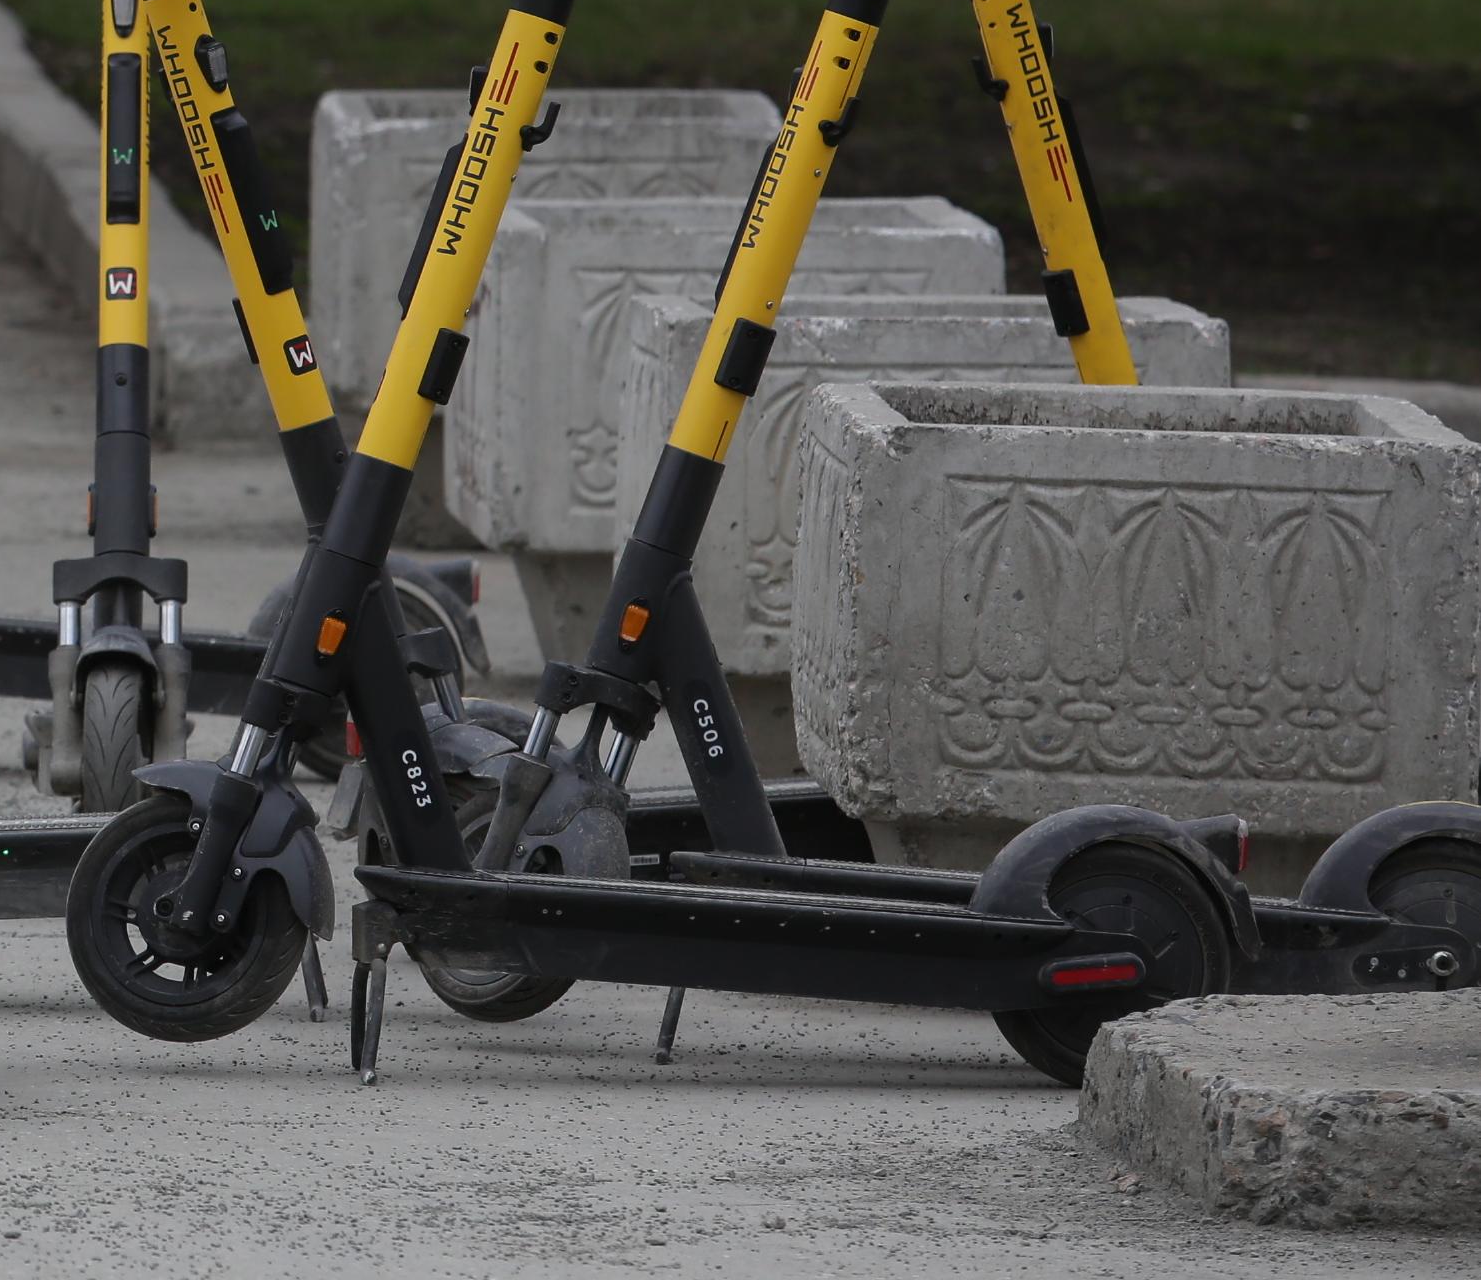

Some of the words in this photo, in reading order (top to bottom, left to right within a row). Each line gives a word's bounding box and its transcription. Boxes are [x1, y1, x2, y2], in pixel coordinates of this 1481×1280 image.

[156, 25, 215, 170] WHOOSH
[1006, 2, 1060, 143] WHOOSH
[112, 148, 133, 165] W
[436, 106, 505, 256] WHOOSH
[741, 104, 805, 249] WHOOSH
[259, 209, 278, 231] W
[108, 273, 133, 295] W
[289, 340, 314, 368] W
[693, 699, 724, 758] C506
[402, 749, 432, 808] C823
